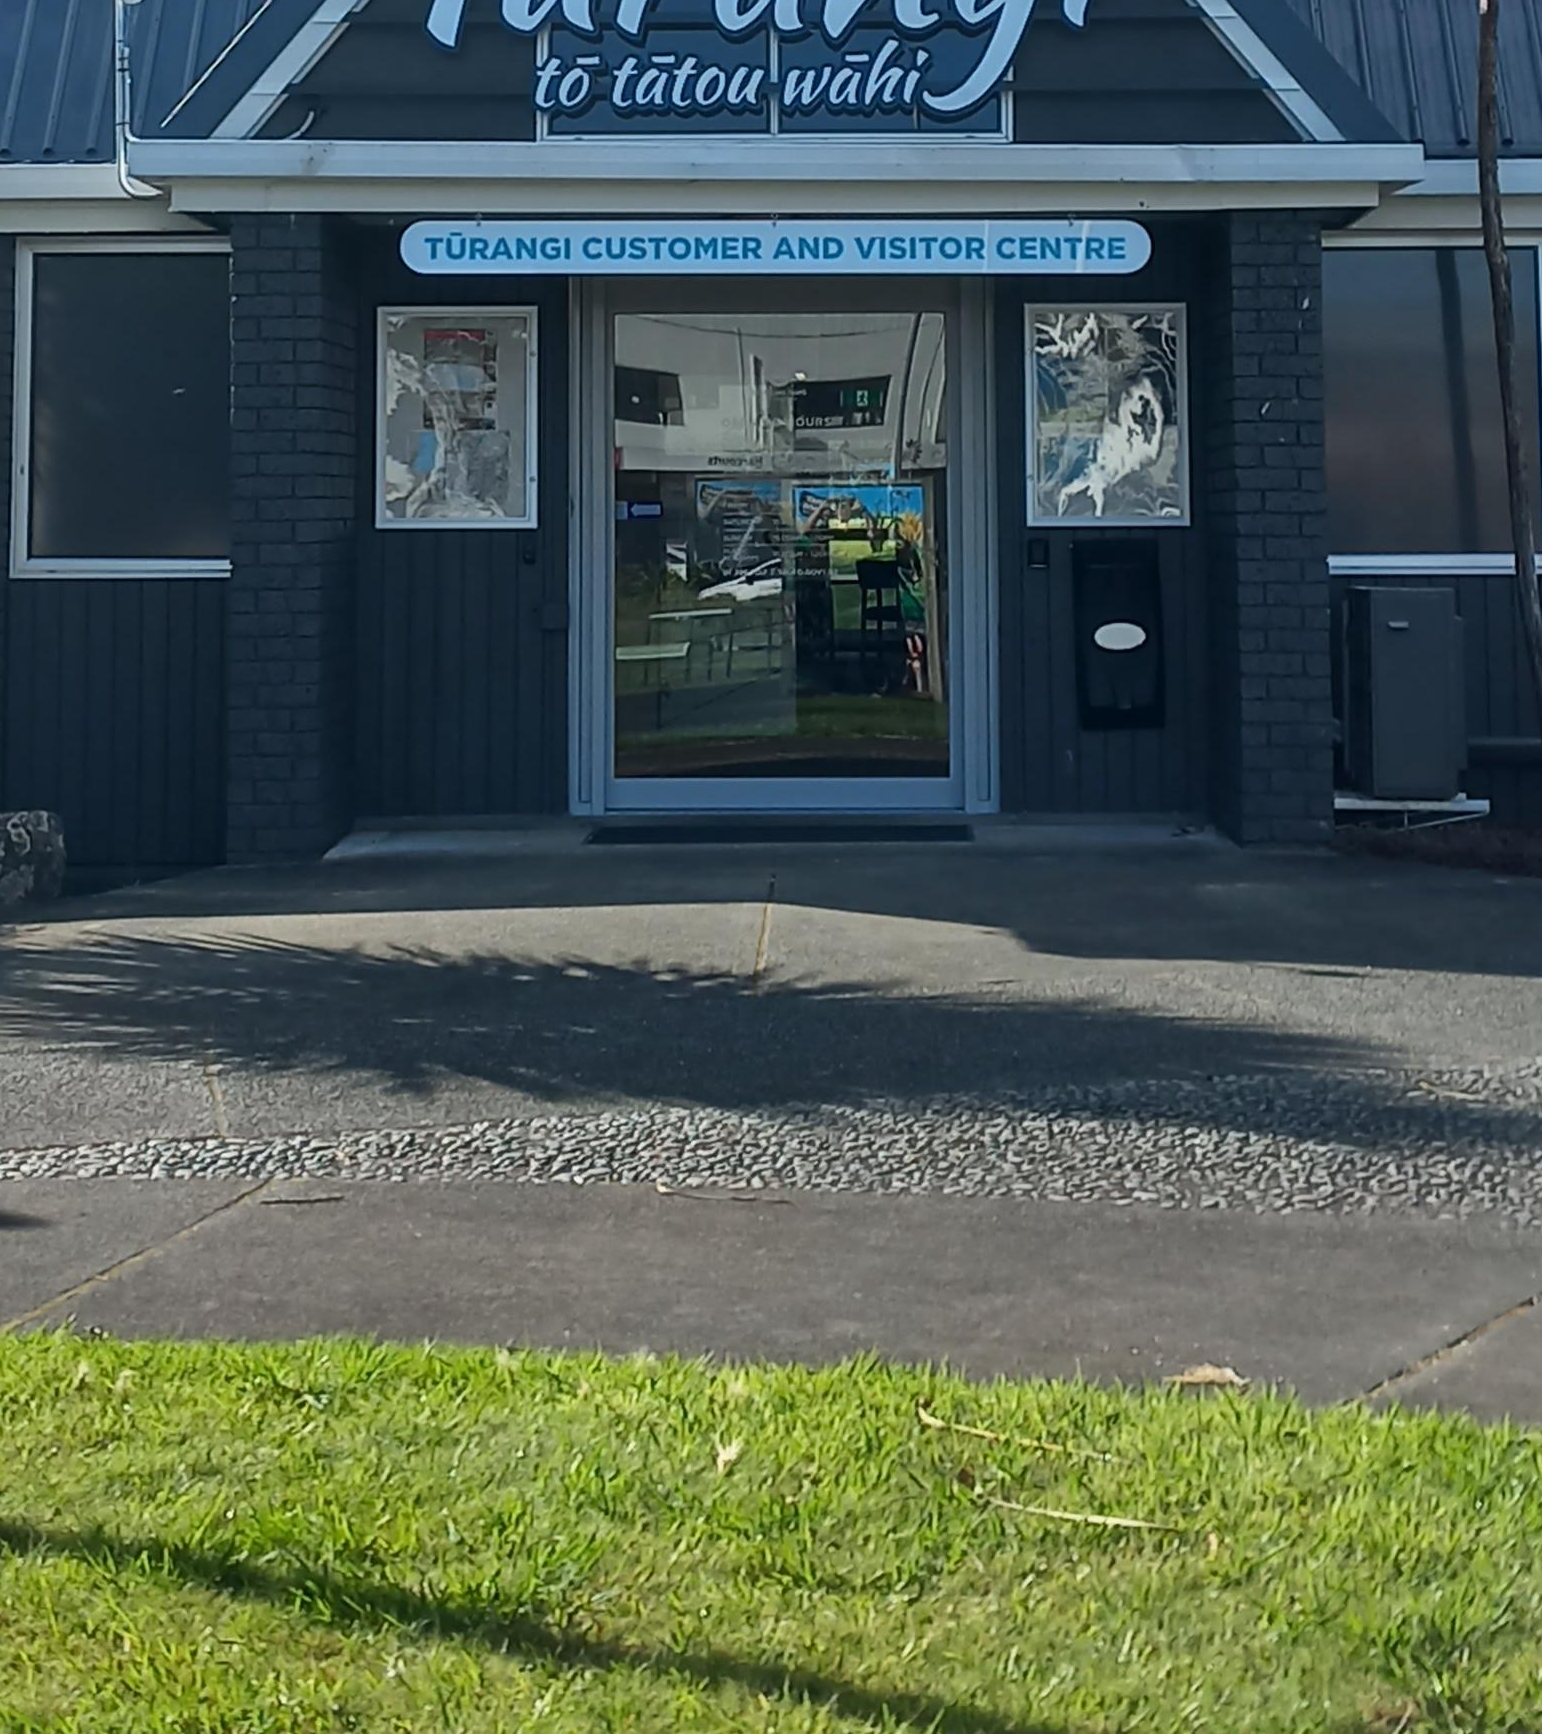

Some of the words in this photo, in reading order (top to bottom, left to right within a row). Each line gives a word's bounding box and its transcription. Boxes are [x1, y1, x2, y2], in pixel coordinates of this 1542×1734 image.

[534, 55, 600, 108] tō
[612, 54, 765, 108] tātou
[782, 39, 929, 106] wāhi
[424, 231, 572, 261] TŪRANGI
[582, 236, 763, 261] CUSTOMER
[772, 236, 844, 260] AND
[854, 236, 986, 260] VISITOR
[995, 236, 1126, 260] CENTRE
